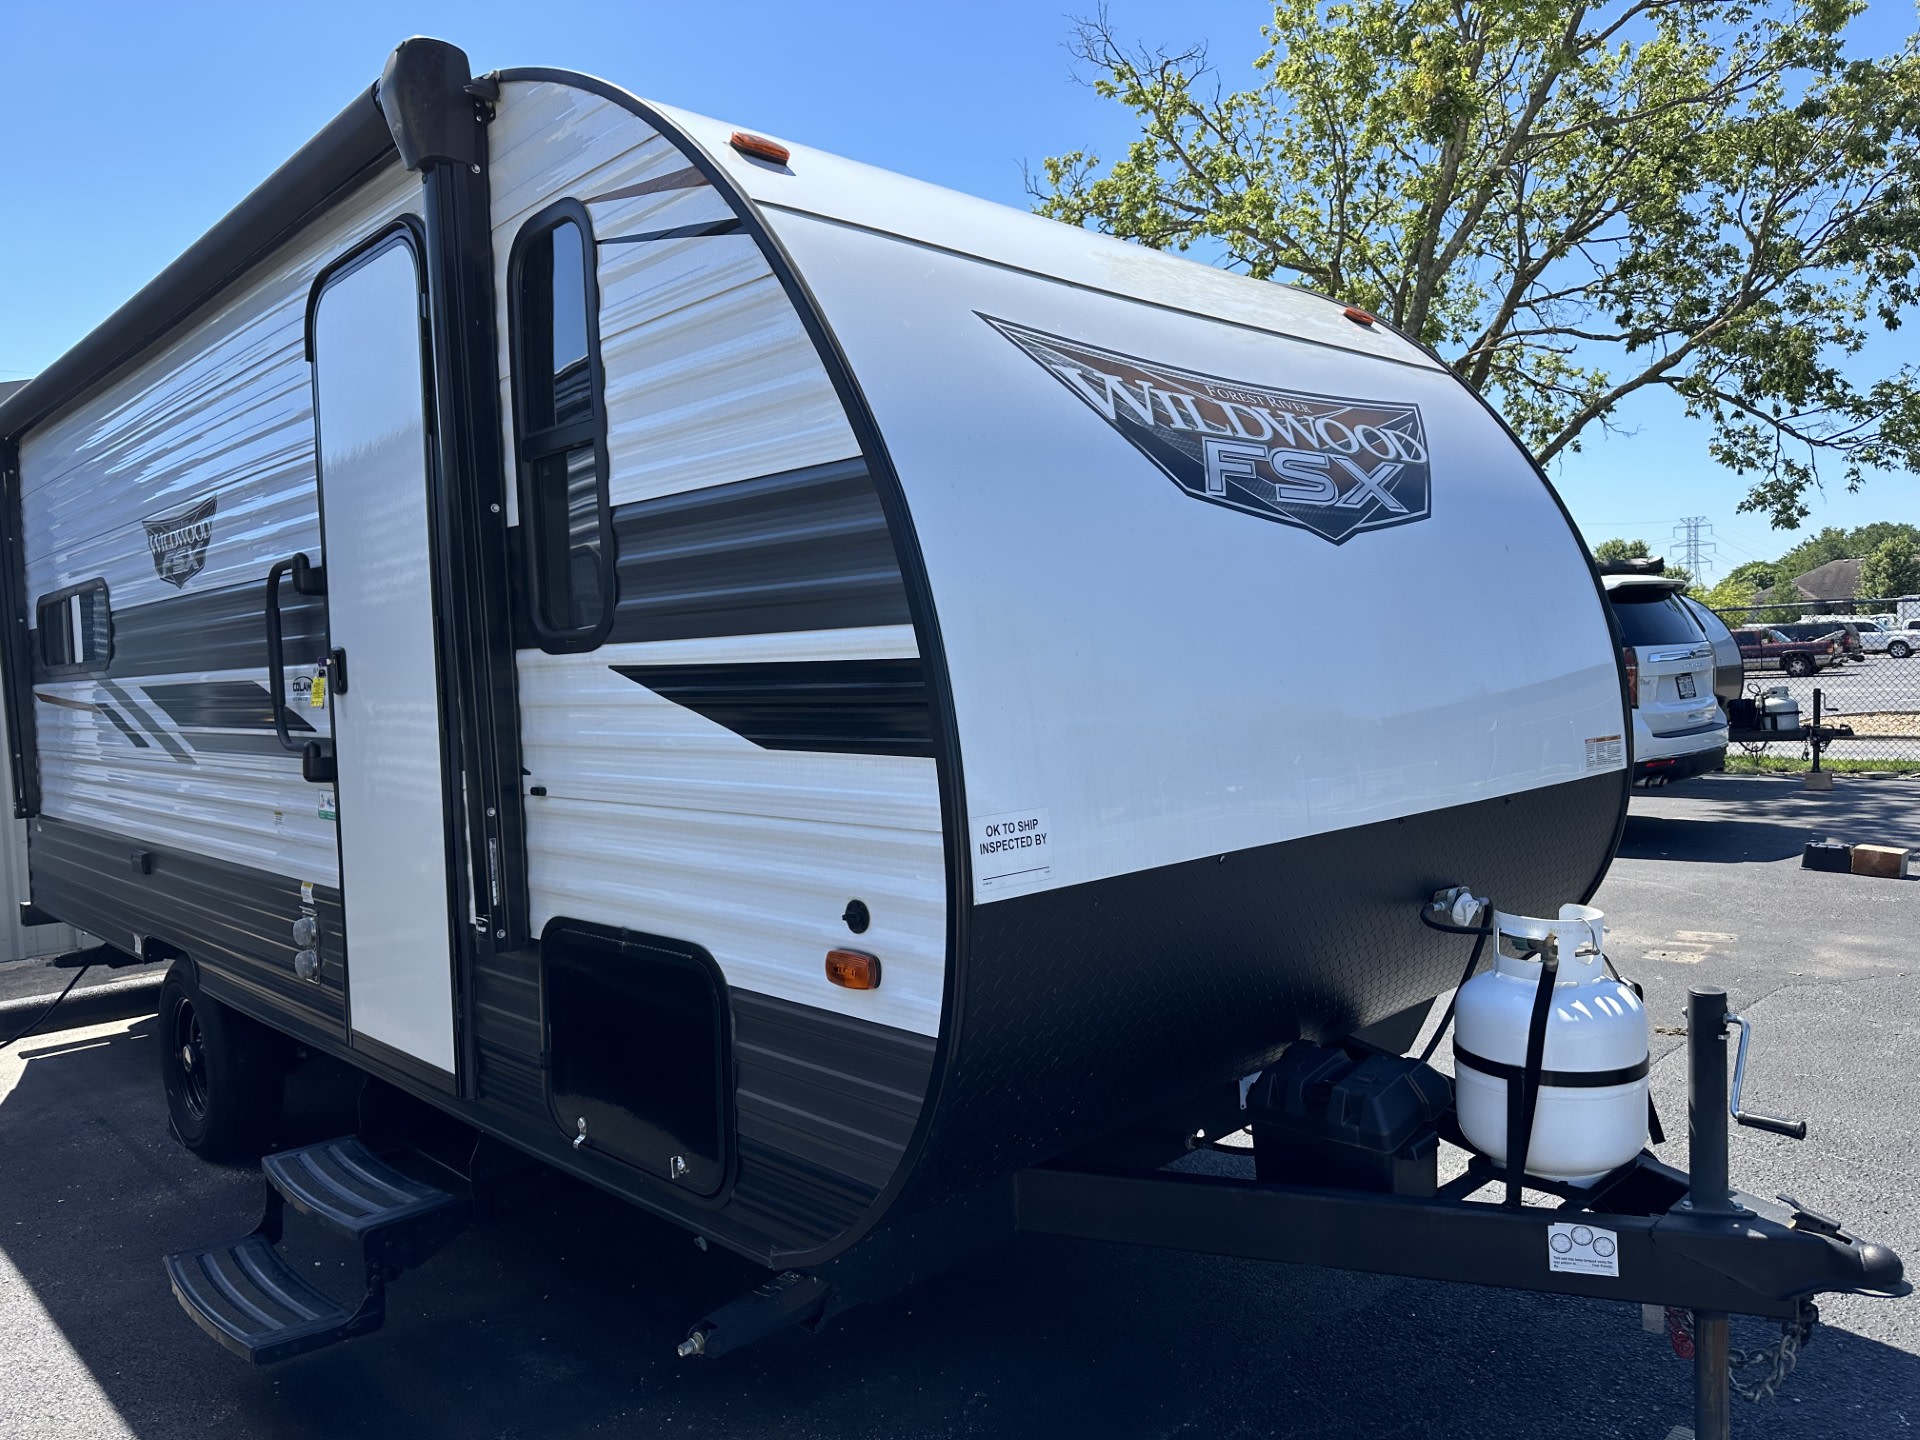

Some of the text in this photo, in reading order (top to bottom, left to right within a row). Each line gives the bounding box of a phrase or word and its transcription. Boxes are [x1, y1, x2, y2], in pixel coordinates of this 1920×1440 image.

[1051, 364, 1428, 464] WILDWOOD
[1204, 385, 1313, 414] FOREST RIVER
[1201, 436, 1410, 514] FSX
[149, 520, 211, 554] WILDWOOD
[986, 818, 1039, 837] OK TO SHIP
[980, 833, 1047, 855] INSPECTED BY
